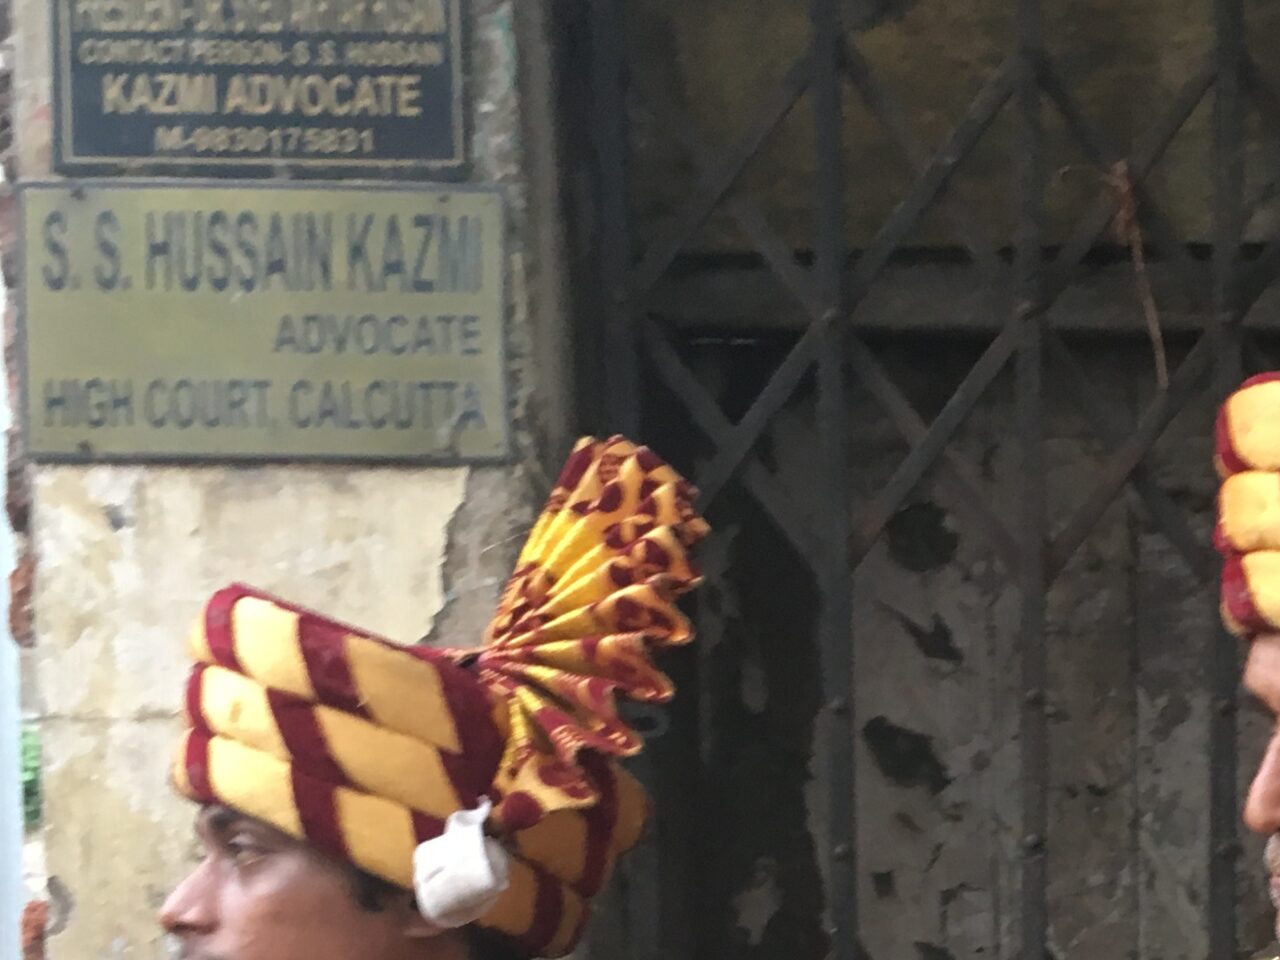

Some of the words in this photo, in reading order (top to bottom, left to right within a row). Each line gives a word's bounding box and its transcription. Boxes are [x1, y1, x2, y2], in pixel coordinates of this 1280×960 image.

[102, 73, 217, 115] KAZMI
[223, 74, 422, 117] ADVOCATE
[145, 210, 334, 293] HUSSAIN
[346, 212, 483, 293] KAZMI
[273, 313, 482, 356] ADVOCATE
[43, 377, 135, 429] HIGH
[288, 378, 486, 430] CALCUTTA
